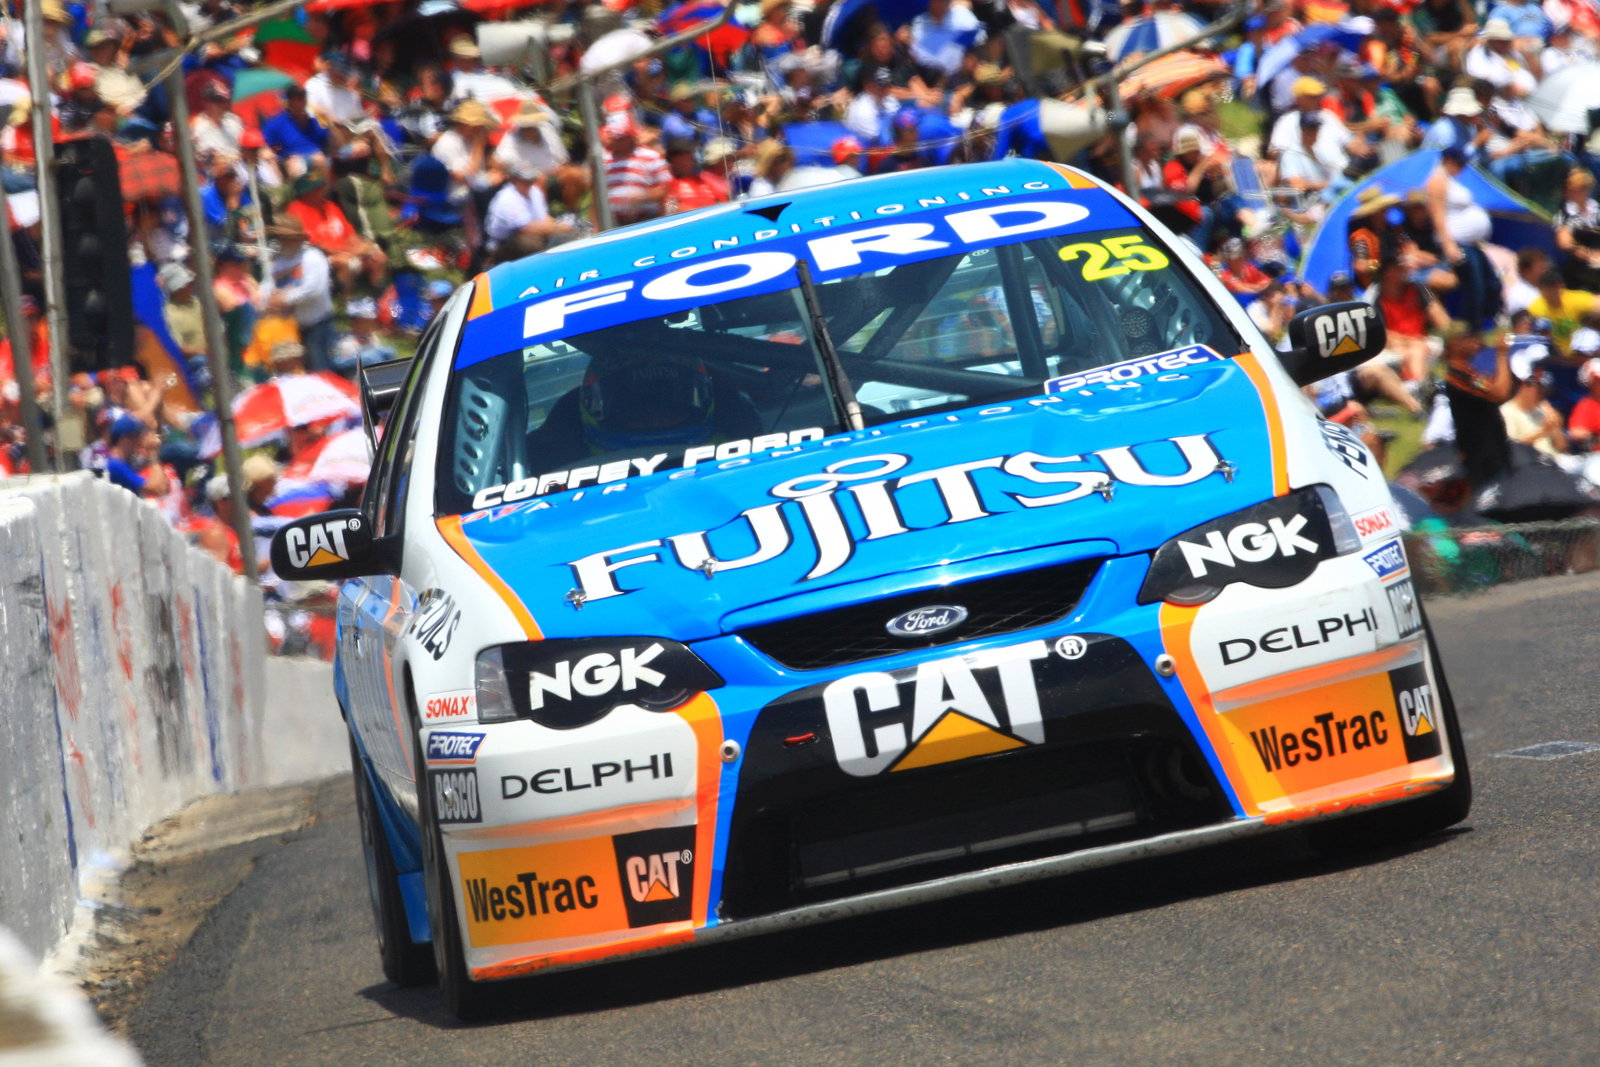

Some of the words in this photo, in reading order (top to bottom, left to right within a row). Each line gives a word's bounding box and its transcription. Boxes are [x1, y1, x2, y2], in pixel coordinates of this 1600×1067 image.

[518, 269, 601, 300] AIR
[633, 181, 1052, 268] CONDITIONING
[1058, 235, 1169, 281] 25
[523, 202, 1090, 339] FORD
[1058, 349, 1209, 392] PROTEC
[472, 453, 667, 510] COFFEY
[683, 427, 825, 469] FORD
[565, 433, 1222, 603] FUJITSU
[1355, 511, 1392, 536] SONAX
[1177, 513, 1319, 578] NGK
[904, 609, 950, 631] Ford
[1219, 607, 1379, 666] DELPHI
[529, 642, 666, 710] NGK
[425, 696, 470, 719] SONAX
[429, 735, 480, 755] PROTEC
[1250, 710, 1388, 772] WesTrac
[500, 752, 673, 800] DELPHI
[466, 872, 598, 922] WesTrac
